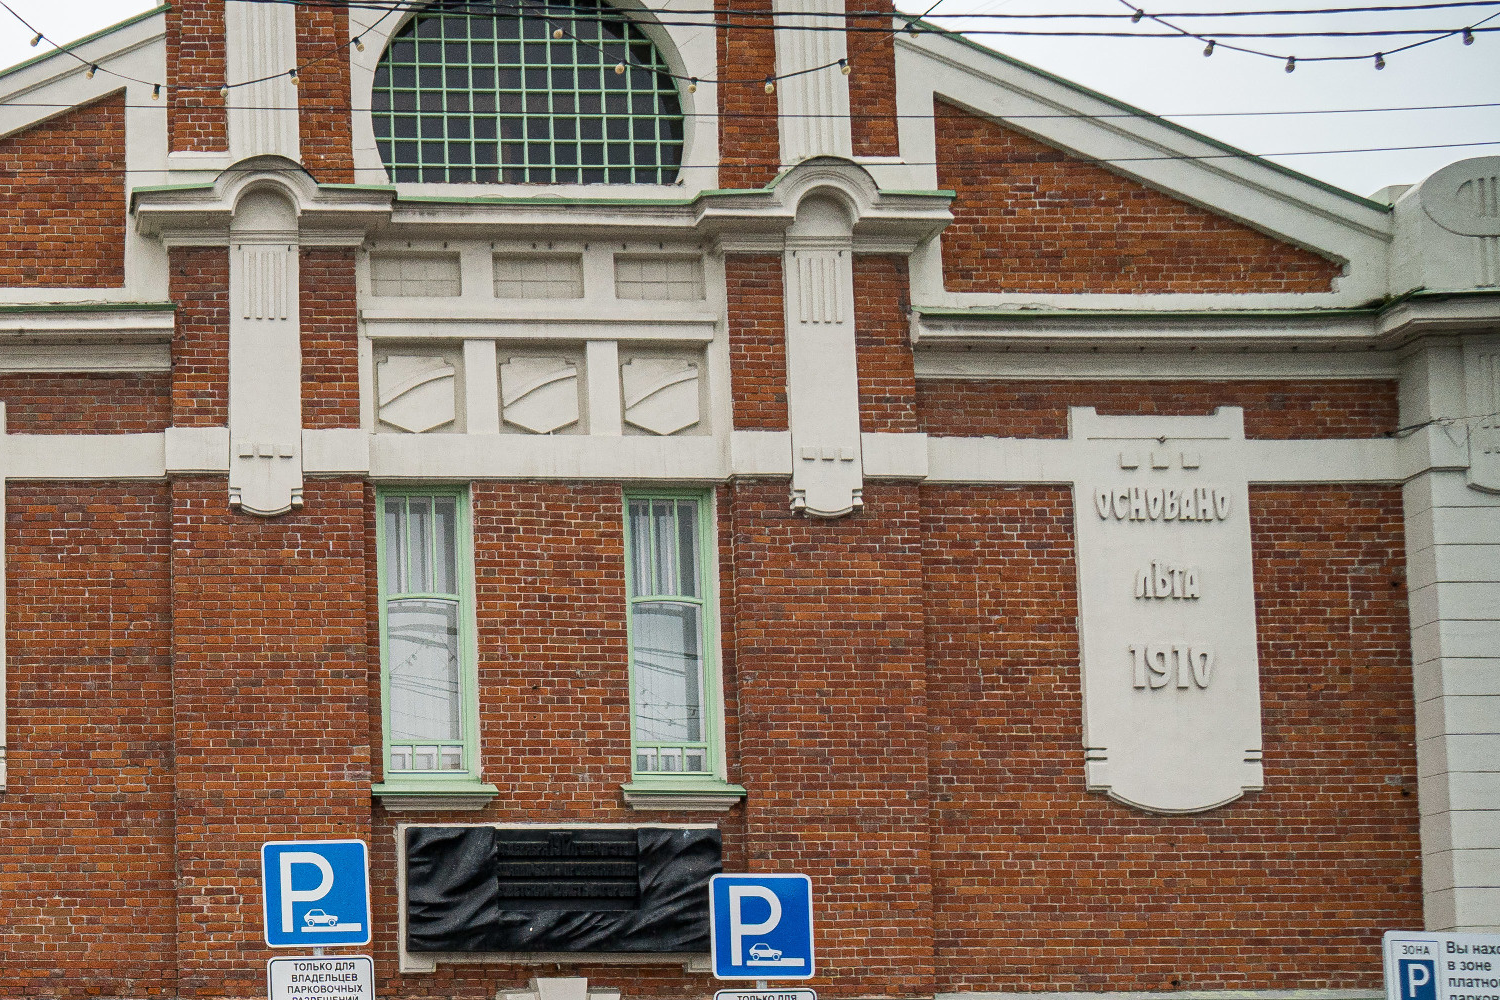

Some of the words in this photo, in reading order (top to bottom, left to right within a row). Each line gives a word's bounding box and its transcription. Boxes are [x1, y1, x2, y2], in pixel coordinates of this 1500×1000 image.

[1093, 487, 1233, 521] ОСНОВАНО
[1128, 643, 1216, 690] 1910
[279, 851, 334, 933] P
[728, 885, 782, 966] P
[1402, 945, 1430, 955] ЗОНА
[1446, 941, 1468, 954] Вы
[294, 963, 332, 971] ТОЛЬКО
[335, 962, 355, 971] ДЛЯ
[1447, 961, 1456, 970] в
[1460, 961, 1491, 971] зоне
[291, 974, 358, 983] ВЛАДЕЛЬЦЕВ
[1407, 963, 1430, 998] P
[287, 985, 363, 994] ПАРКОВОЧНЫХ
